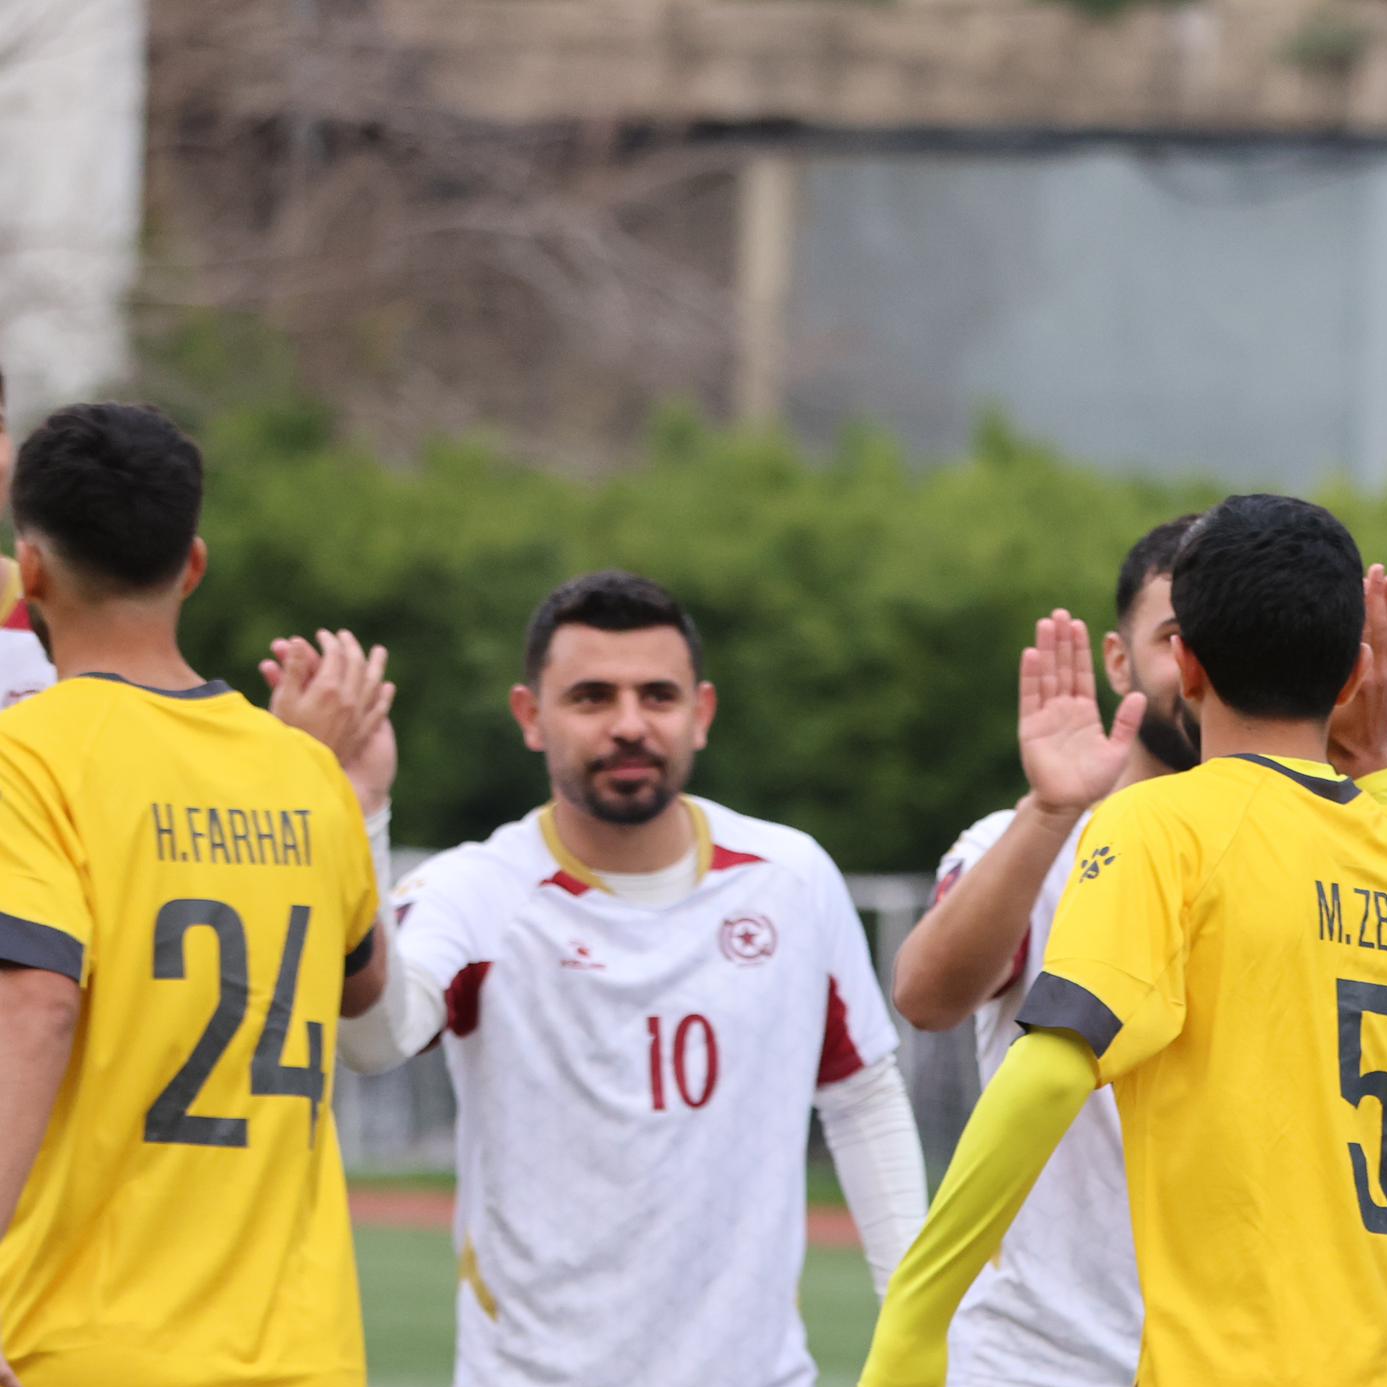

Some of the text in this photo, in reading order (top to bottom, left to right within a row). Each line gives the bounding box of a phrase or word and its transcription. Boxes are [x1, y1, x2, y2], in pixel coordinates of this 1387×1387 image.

[152, 802, 313, 867] H.FARHAT
[143, 898, 326, 1151] 24
[646, 1013, 719, 1111] 10
